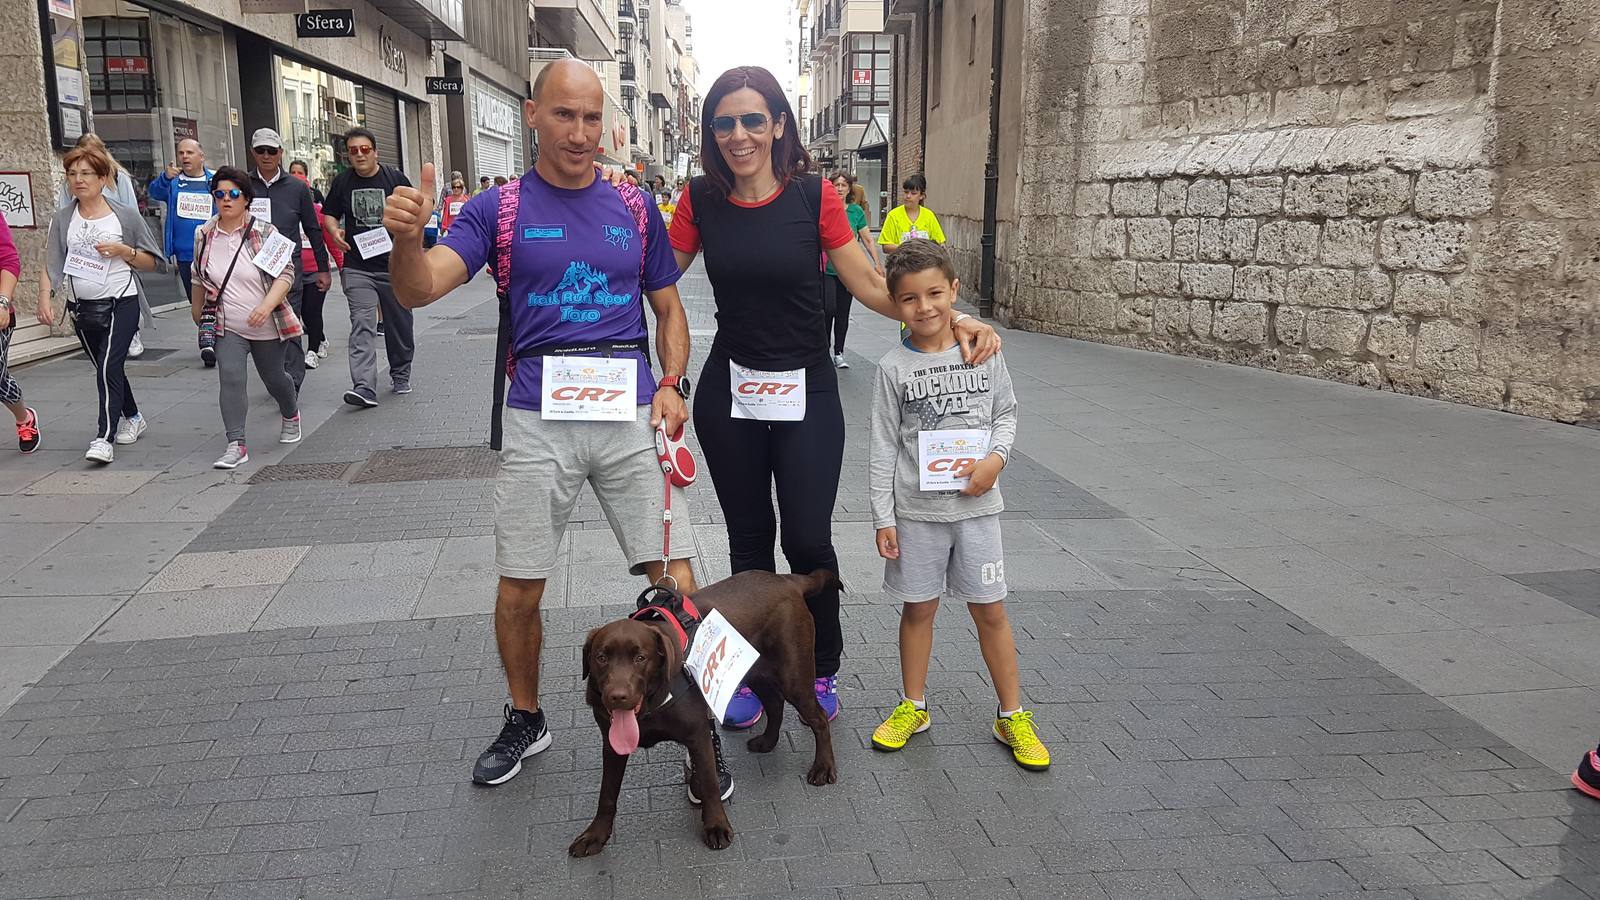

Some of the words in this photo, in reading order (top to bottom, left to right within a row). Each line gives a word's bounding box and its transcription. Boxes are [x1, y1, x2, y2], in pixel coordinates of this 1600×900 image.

[602, 225, 633, 239] TORO
[602, 233, 629, 250] 2016
[528, 292, 560, 307] Trail
[561, 291, 592, 305] Run
[560, 306, 601, 322] Toro
[912, 368, 928, 378] THE
[928, 365, 947, 375] TRUE
[551, 386, 627, 402] CR7
[737, 381, 799, 395] CR7
[904, 371, 990, 402] ROCKDOG
[928, 393, 970, 417] VII
[927, 457, 984, 473] CR
[702, 635, 727, 694] CR7
